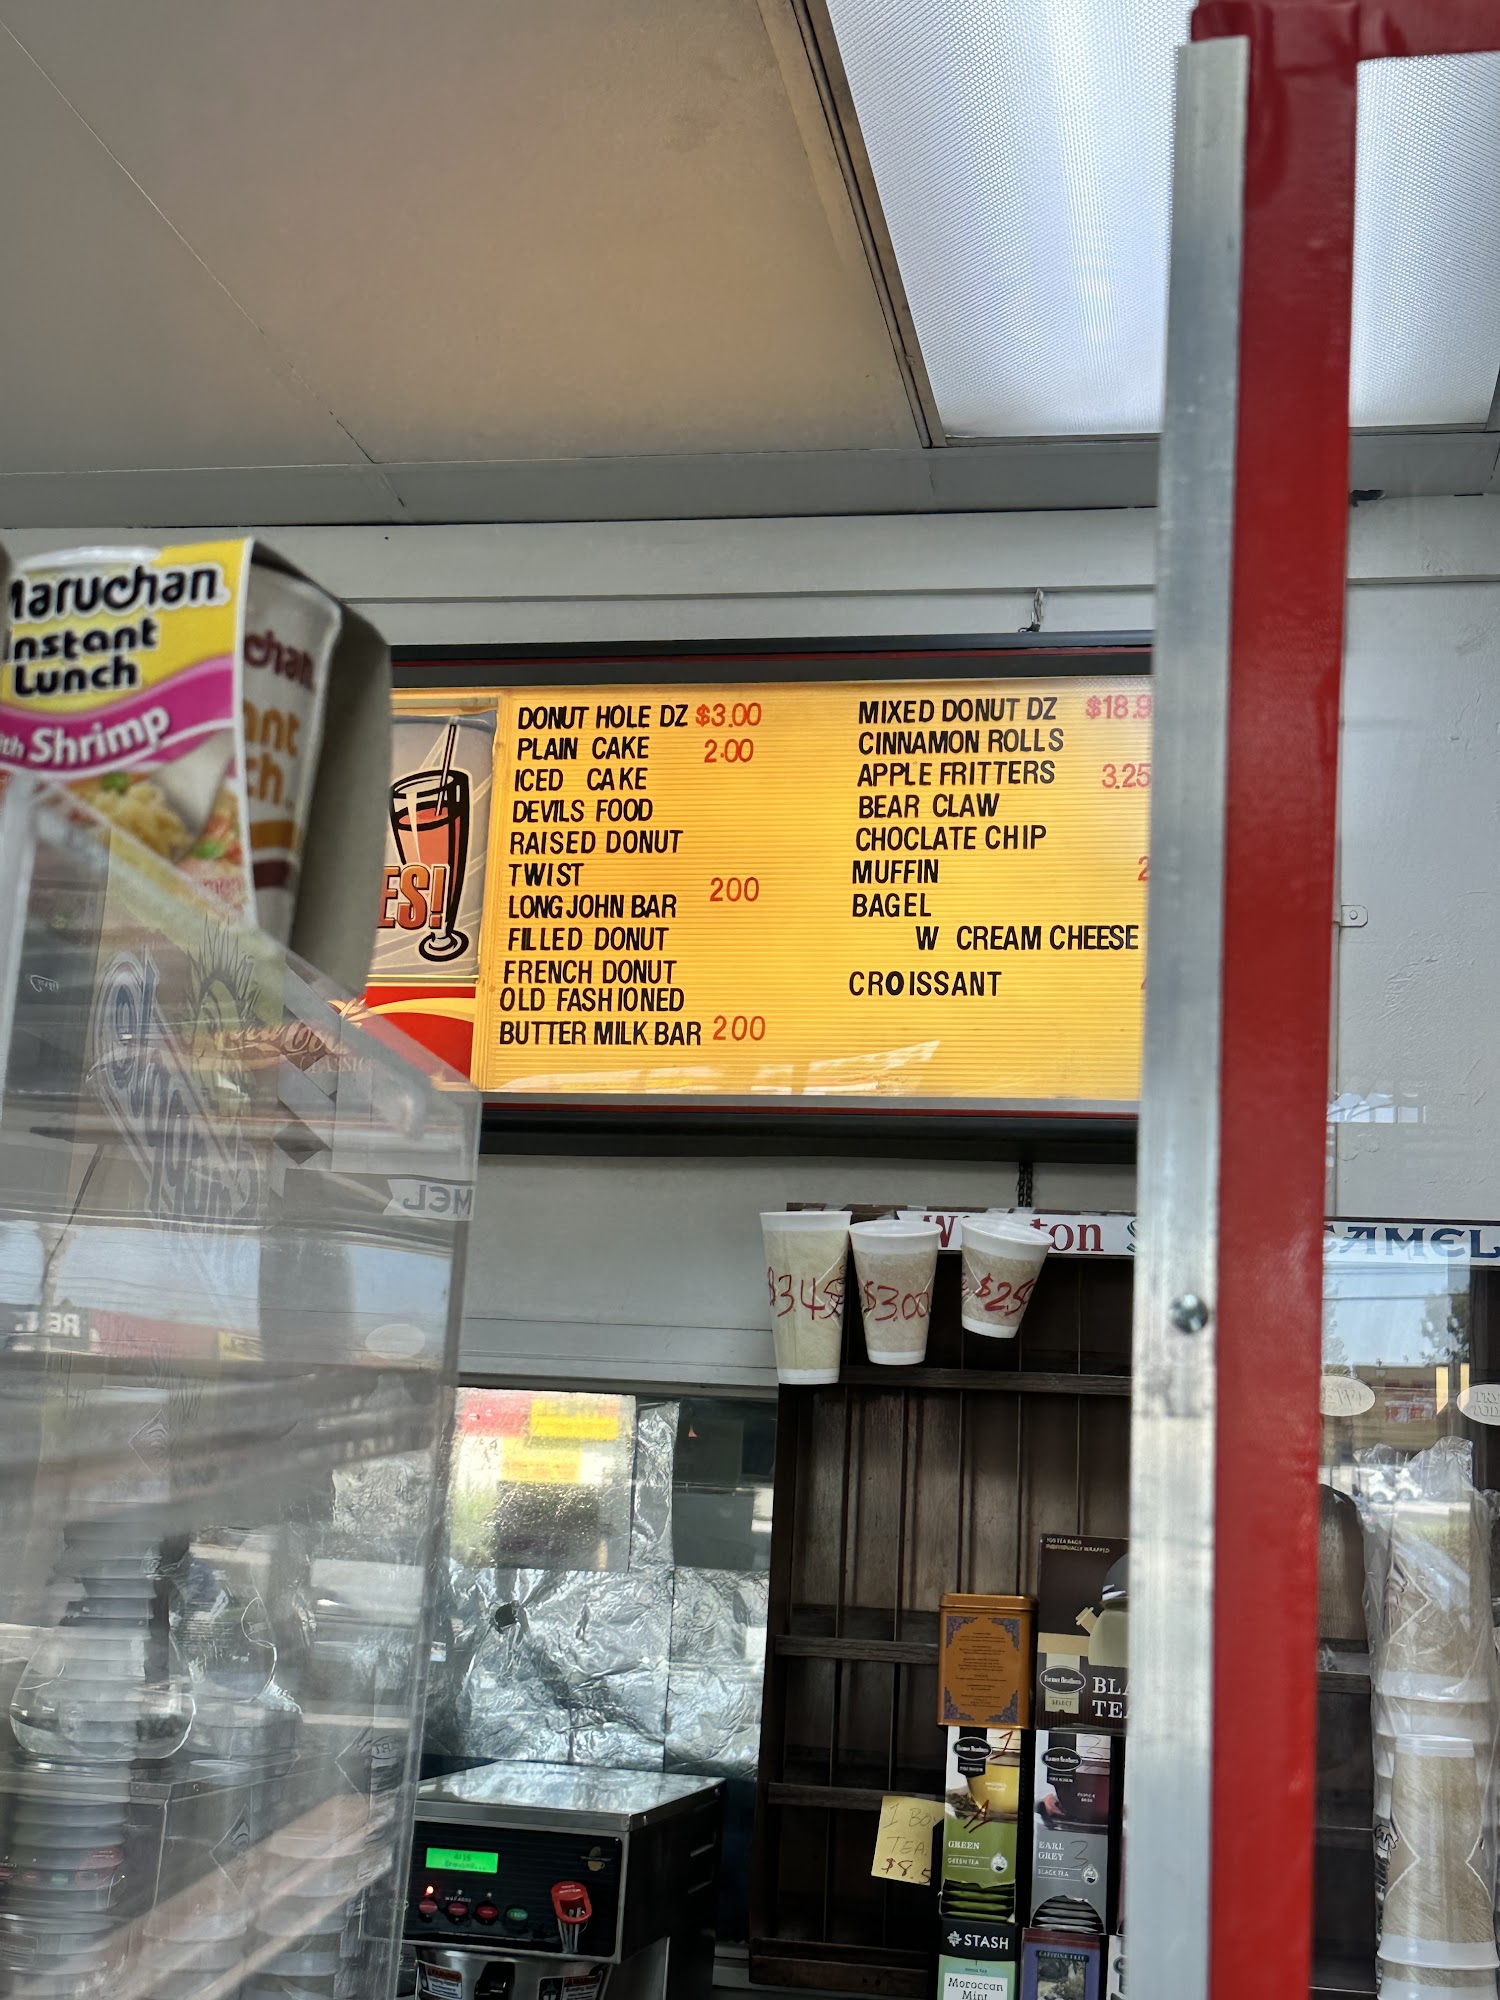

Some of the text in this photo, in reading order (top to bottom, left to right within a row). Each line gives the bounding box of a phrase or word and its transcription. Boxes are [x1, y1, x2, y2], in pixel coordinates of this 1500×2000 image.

[15, 656, 137, 697] Lunch
[518, 702, 762, 730] DONUT HOLE DZ $3.00
[858, 699, 935, 724] MIXED
[942, 698, 1020, 722] DONUT
[1027, 697, 1058, 721] DZ
[30, 706, 169, 764] Shrimp
[858, 728, 1063, 755] CINNAMON ROLLS
[517, 736, 754, 763] PLAIN CAKE 2.00
[514, 767, 648, 792] ICED CAKE
[858, 762, 932, 787] APPLE
[940, 760, 1055, 786] FRITTERS
[512, 798, 653, 823] DEVILS FOOD
[859, 793, 1000, 819] BEAR CLAW
[510, 829, 684, 855] RAISED DONUT
[855, 824, 1047, 852] CHOCLATE CHIP
[508, 862, 585, 887] TWIST
[852, 858, 939, 884] MUFFIN
[631, 894, 677, 919] BAR
[852, 892, 932, 918] BAGEL
[508, 926, 670, 951] FILLED DONUT
[915, 925, 1138, 951] W CREAM CHEESE
[503, 959, 677, 984] FRENCH DONUT
[849, 970, 1002, 997] CROISSANT
[499, 986, 685, 1012] OLD FASHIONED
[499, 1020, 587, 1045] BUTTER
[593, 1021, 648, 1046] MILK
[654, 1021, 702, 1046] BAR
[1092, 1699, 1130, 1719] TE
[948, 1841, 980, 1850] GREEN
[1038, 1841, 1065, 1850] EARL
[1038, 1852, 1064, 1861] GREY
[963, 1933, 1009, 1950] STASH
[948, 1977, 1004, 1992] Moroccan
